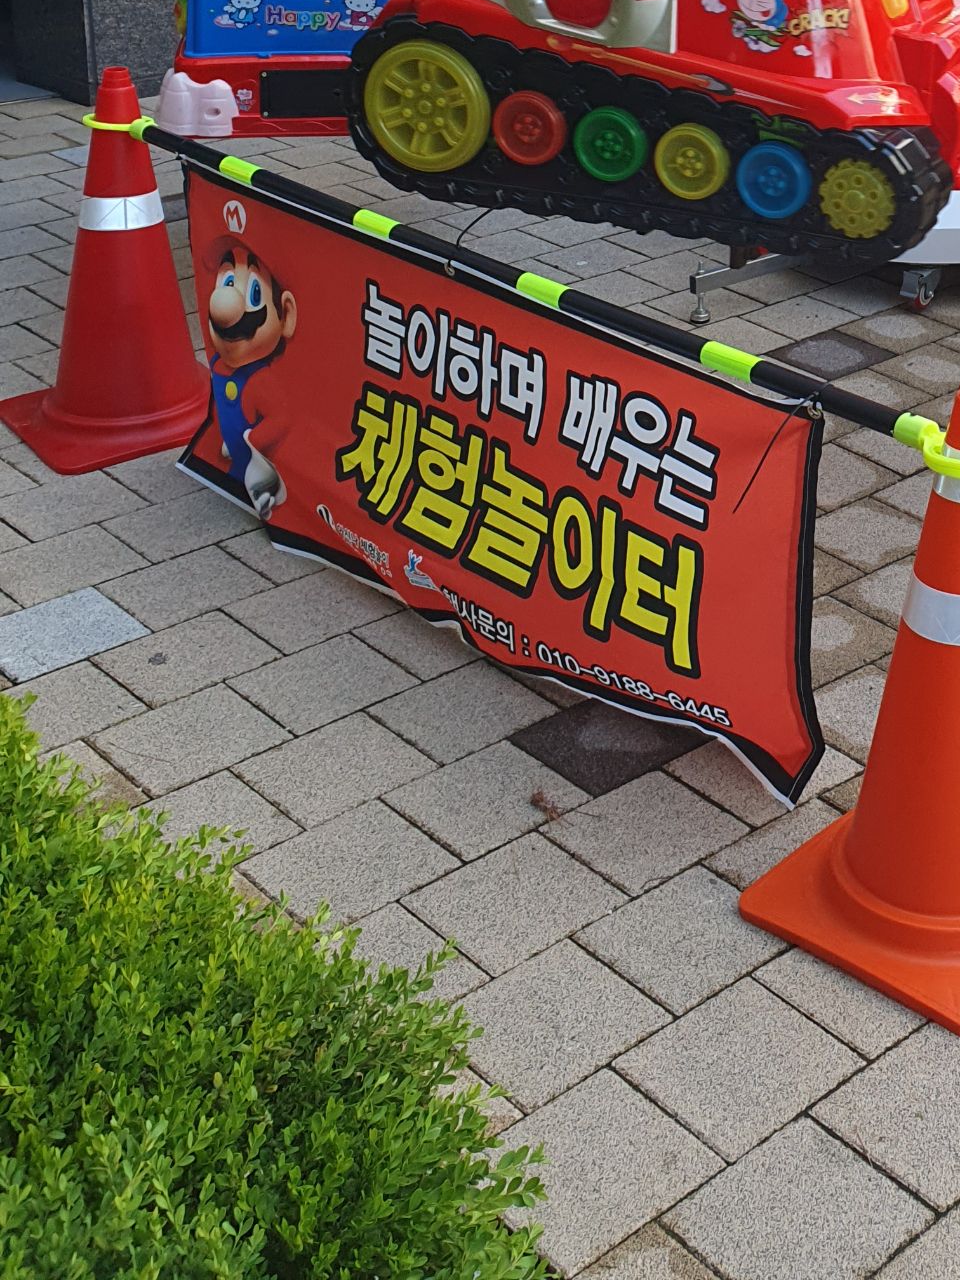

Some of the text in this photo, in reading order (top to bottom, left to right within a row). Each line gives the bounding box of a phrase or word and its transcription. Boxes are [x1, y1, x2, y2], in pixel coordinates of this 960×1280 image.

[266, 4, 340, 31] Happy
[364, 284, 716, 524] 놀이하며 배우는
[341, 390, 697, 670] 체험놀이터
[537, 643, 731, 727] 010-9188-6445
